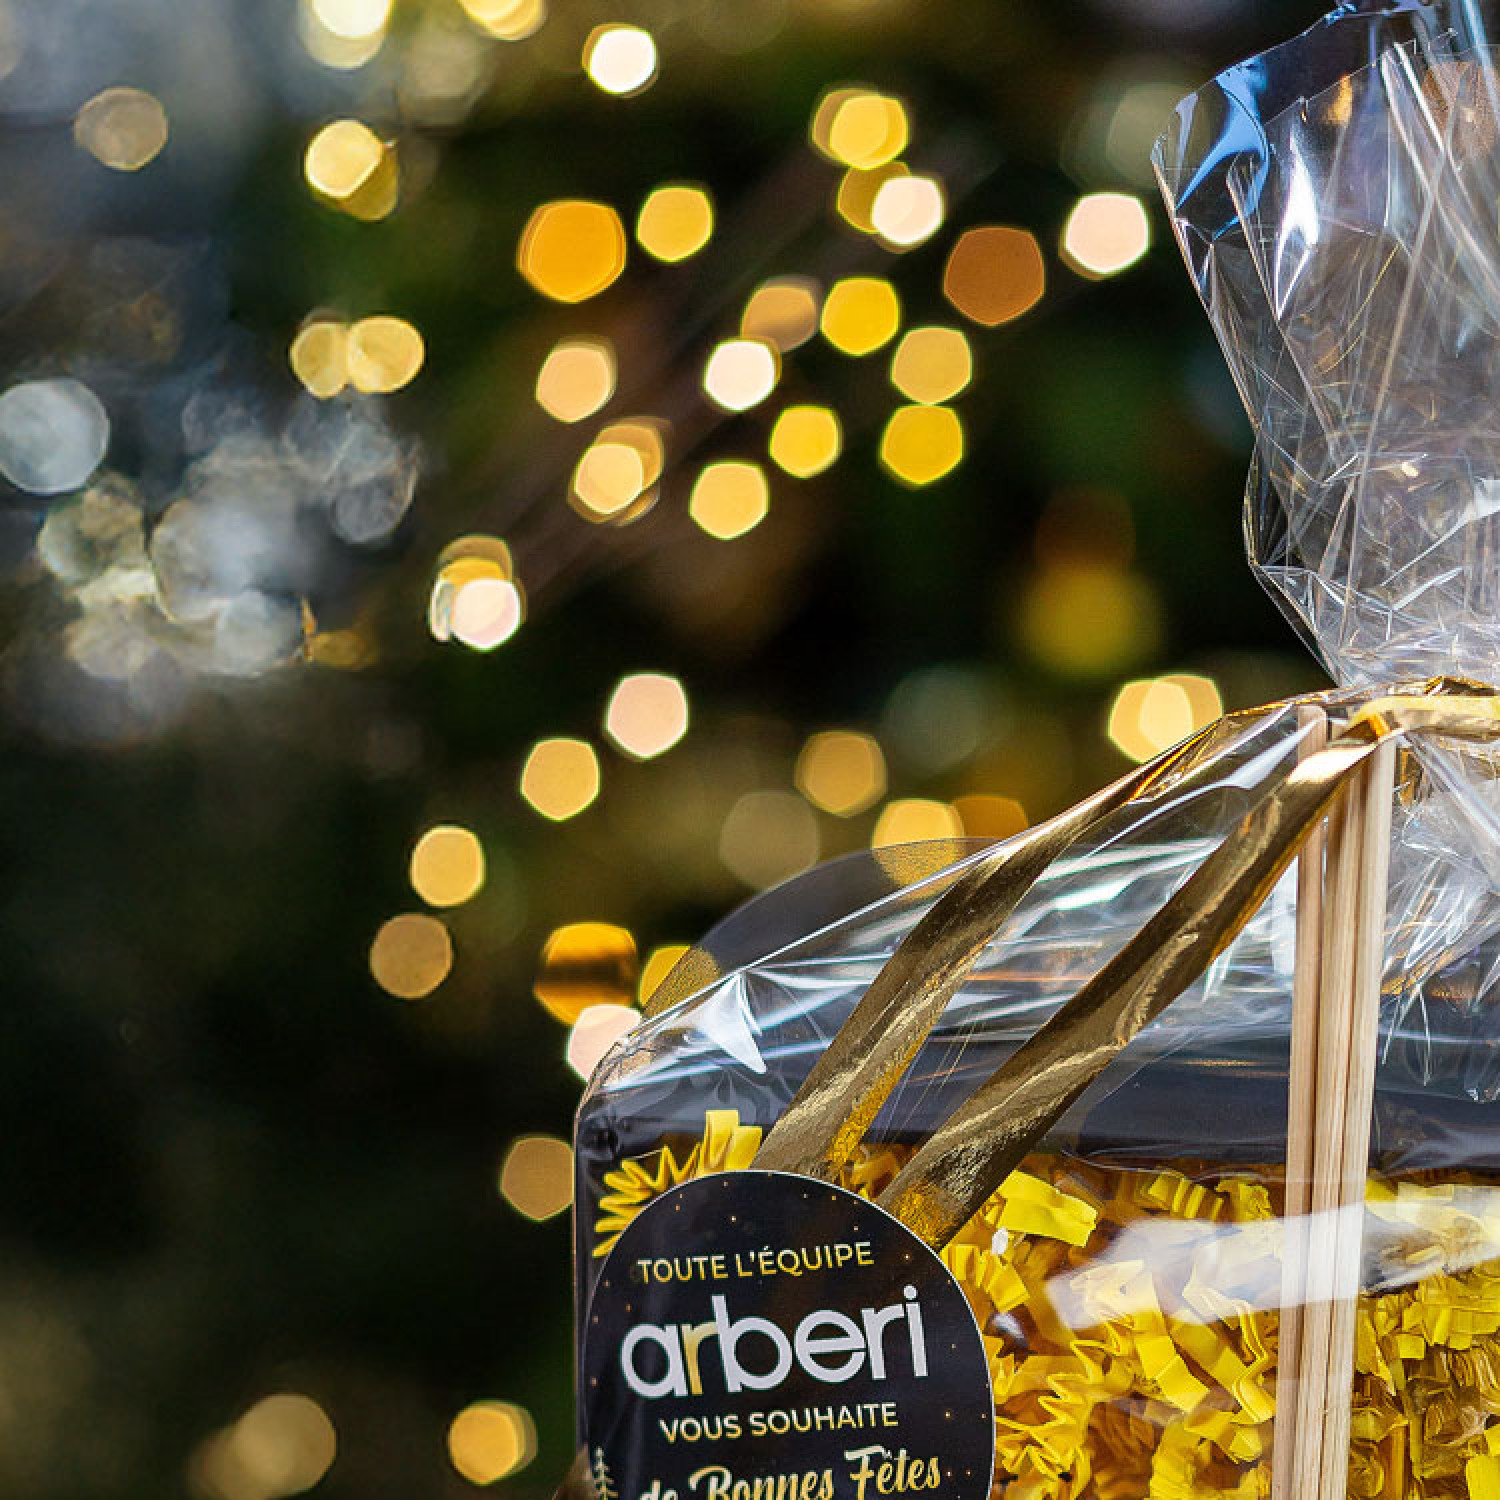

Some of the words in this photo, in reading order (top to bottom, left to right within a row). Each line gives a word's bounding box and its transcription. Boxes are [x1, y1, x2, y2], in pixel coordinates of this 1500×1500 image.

[637, 1253, 728, 1284] TOUTE
[735, 1241, 874, 1279] L'ÉQUIPE
[620, 1285, 928, 1398] arberi
[660, 1412, 742, 1444] VOUS
[748, 1402, 899, 1437] SOUHAITE
[844, 1445, 941, 1500] Fêtes
